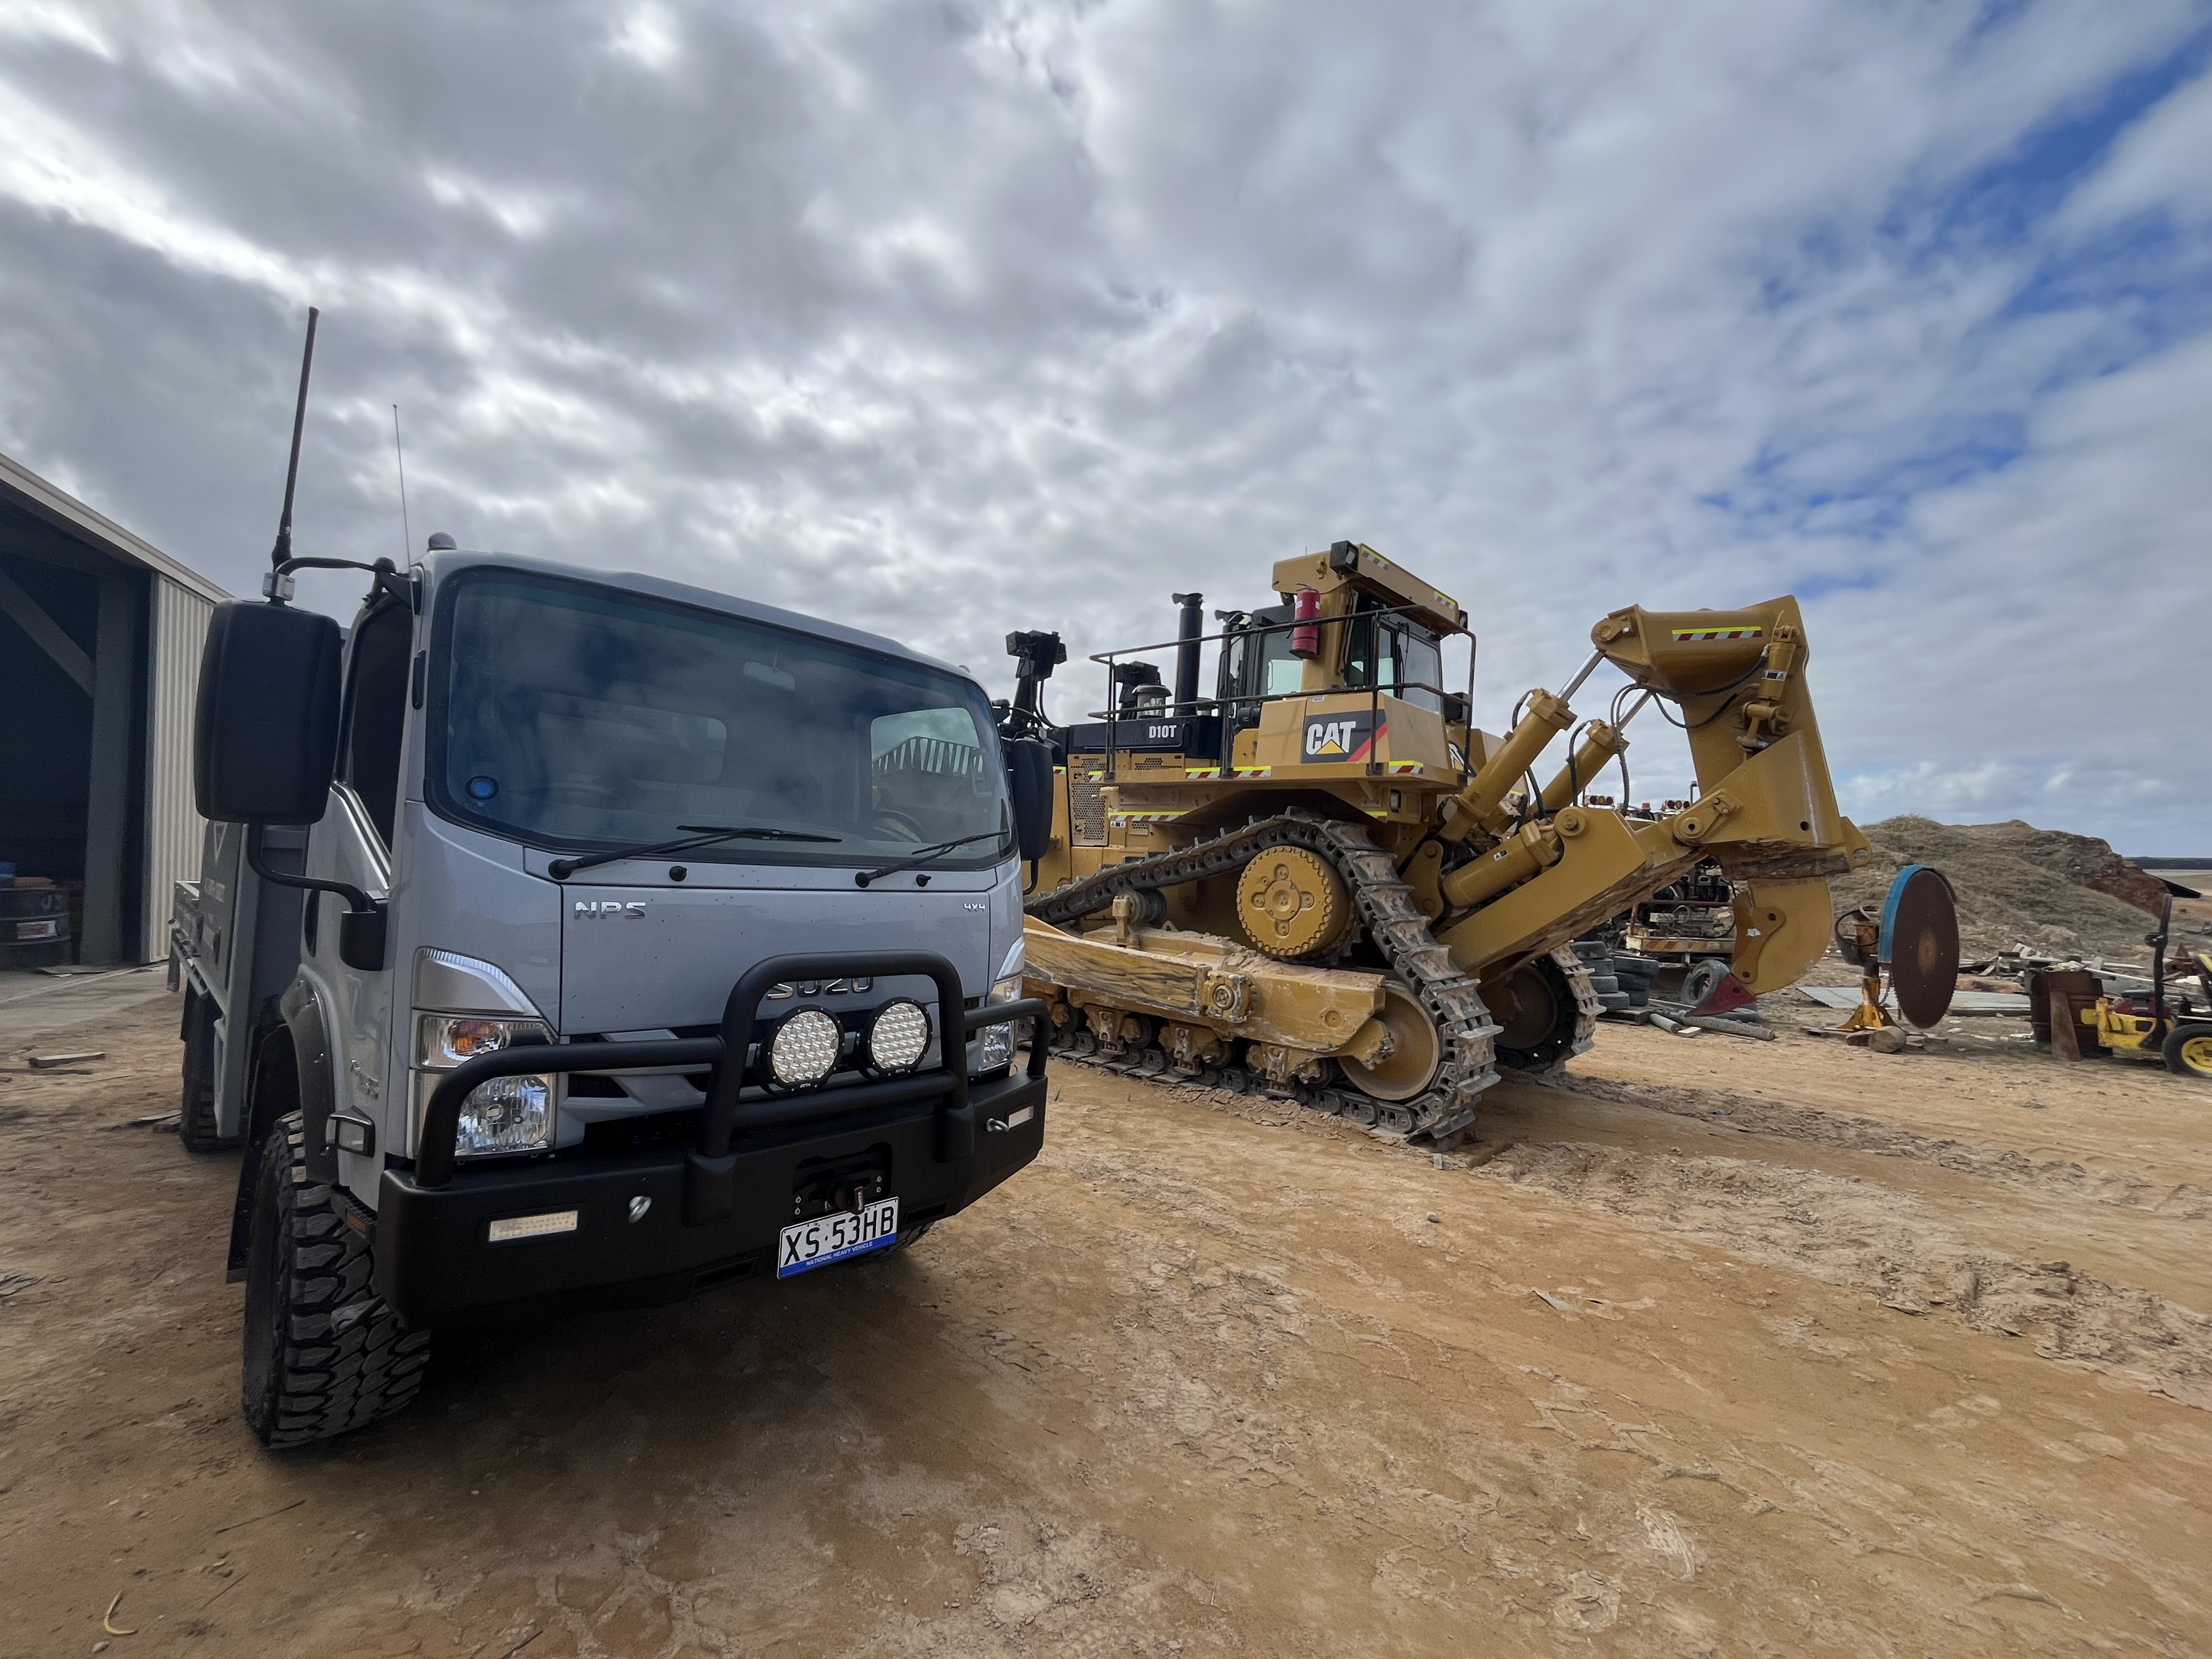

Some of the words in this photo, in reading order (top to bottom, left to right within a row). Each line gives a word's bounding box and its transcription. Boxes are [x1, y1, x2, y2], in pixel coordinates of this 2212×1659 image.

[1149, 725, 1177, 738] D10T
[1306, 721, 1356, 755] CAT
[574, 901, 646, 919] NPS
[806, 1255, 832, 1266] NATIONAL
[833, 1248, 851, 1258] HEAVY
[852, 1242, 873, 1251] VEHICLE
